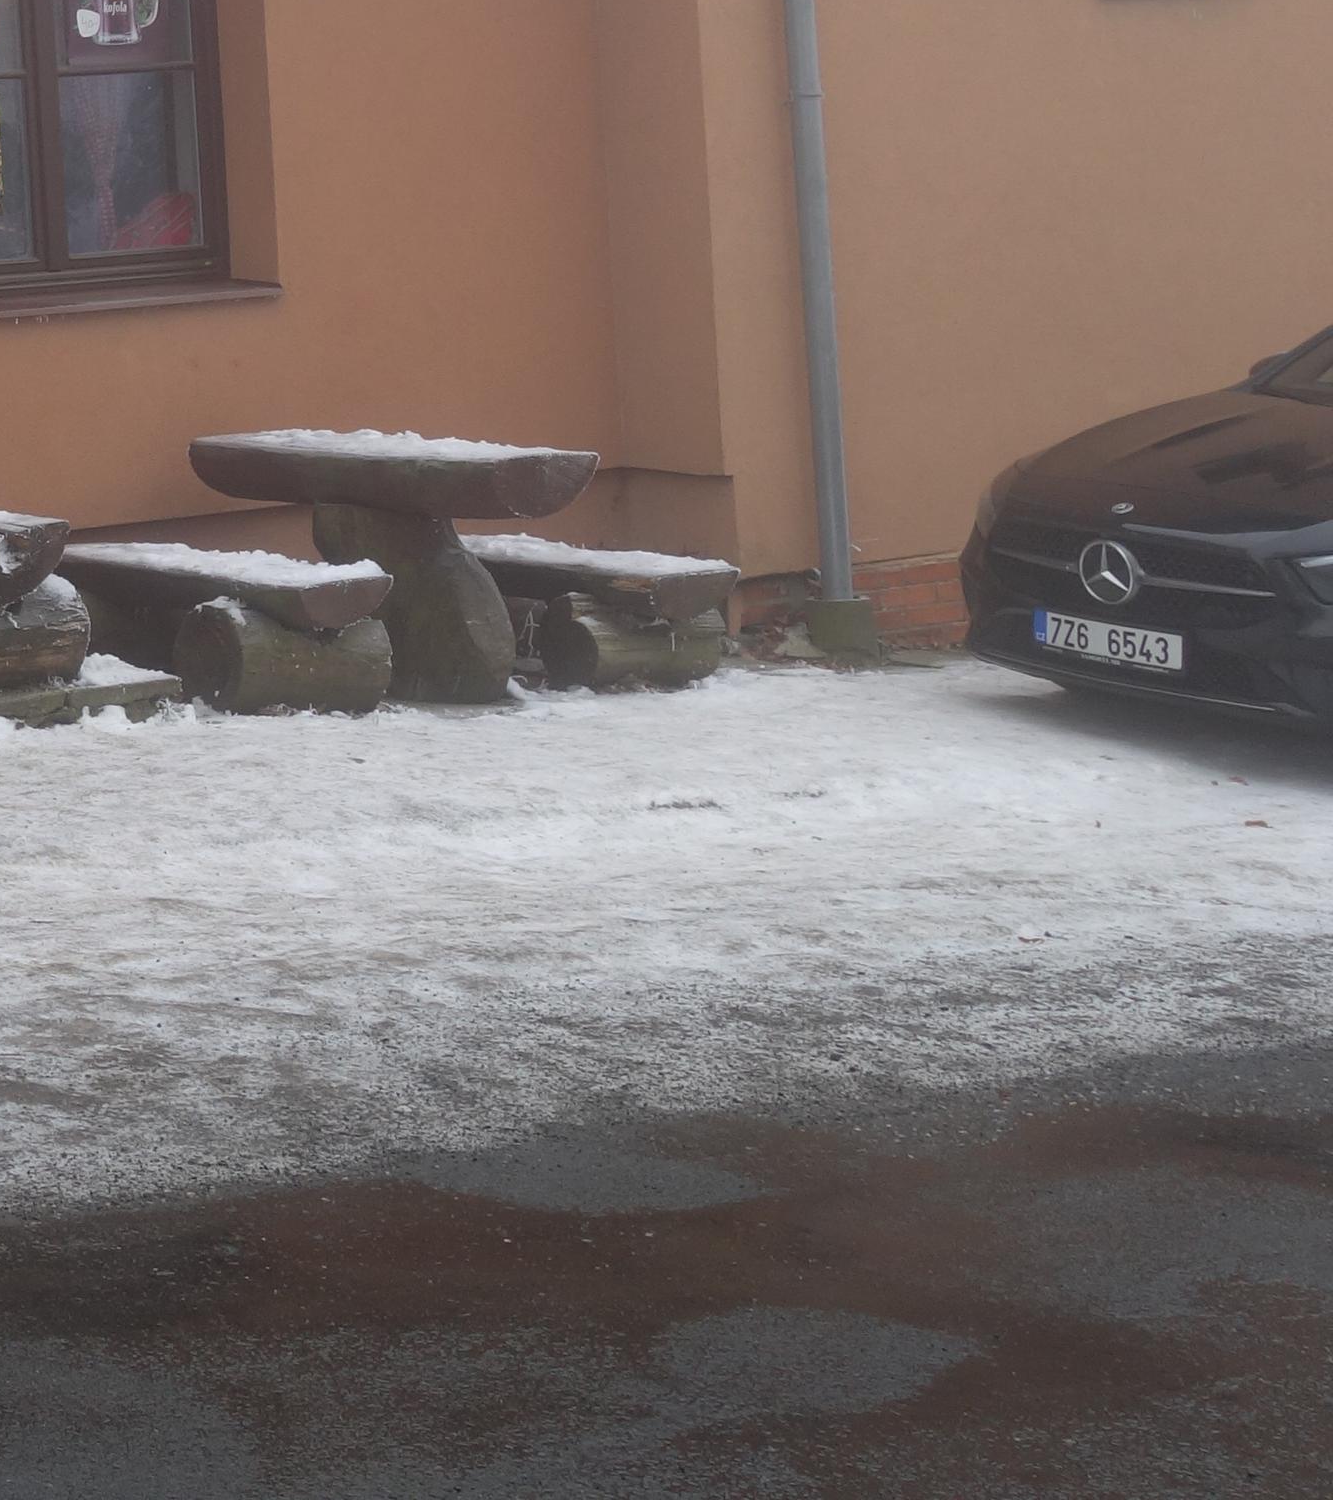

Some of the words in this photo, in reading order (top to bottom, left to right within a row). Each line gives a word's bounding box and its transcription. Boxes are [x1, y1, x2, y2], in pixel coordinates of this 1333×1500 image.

[103, 0, 127, 16] kofola
[1051, 616, 1089, 650] 7Z6
[1107, 628, 1169, 664] 6543
